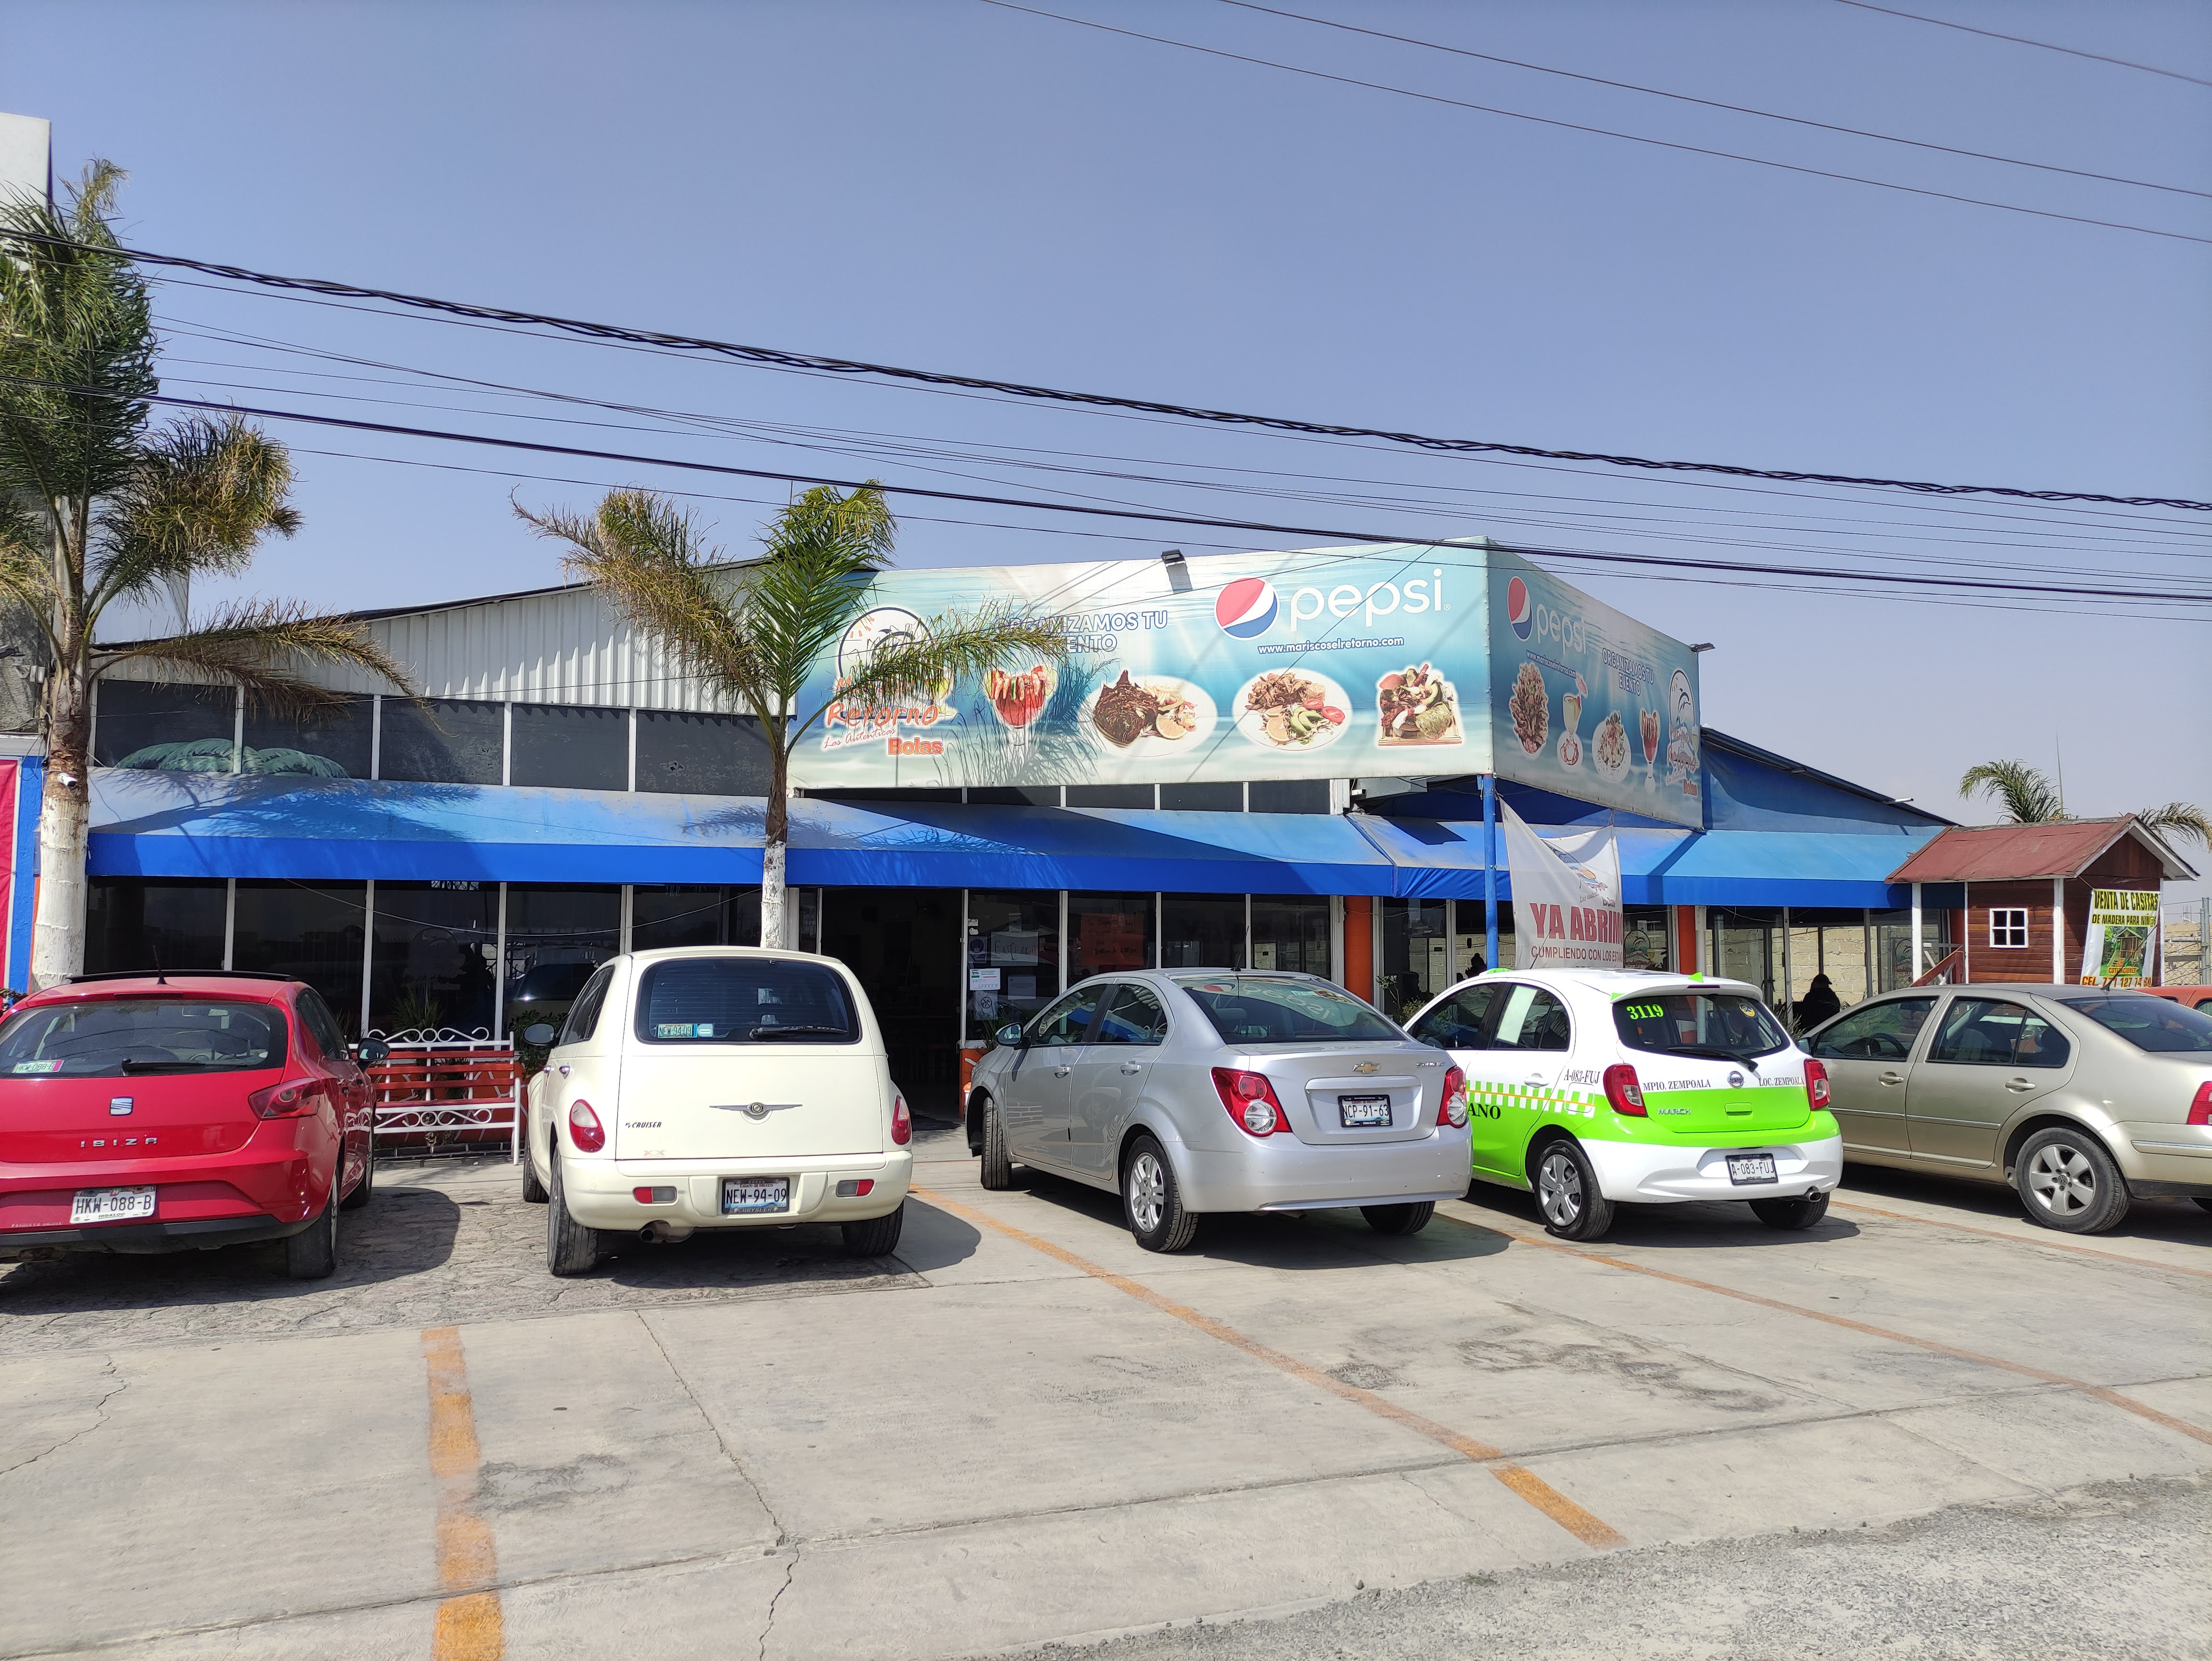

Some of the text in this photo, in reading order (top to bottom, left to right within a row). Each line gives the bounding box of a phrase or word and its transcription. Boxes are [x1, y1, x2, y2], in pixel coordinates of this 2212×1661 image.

[1291, 568, 1442, 632] pepsi
[1142, 610, 1168, 629] TU
[1537, 603, 1586, 656] pepsi
[1258, 636, 1404, 654] www.mariscoselretorno.com
[1602, 648, 1653, 684] ORGANIZAMOS TU
[1618, 672, 1640, 696] EVENTO
[888, 737, 943, 755] Bolas
[2094, 891, 2158, 911] VENTA DE CASITAS
[1529, 903, 1565, 940] YA
[2092, 914, 2100, 924] DE
[2102, 915, 2124, 924] MADERA
[2126, 916, 2139, 925] PARA
[1531, 946, 1586, 960] CUMPLIENDO
[1589, 949, 1601, 961] CON
[1603, 950, 1611, 961] LOS
[2120, 977, 2132, 987] 127
[2134, 977, 2141, 987] 74
[1626, 1004, 1664, 1019] 3119
[1564, 1069, 1601, 1084] A-083-FUJ
[1759, 1076, 1804, 1086] LOC. ZEMPOALA
[1643, 1079, 1711, 1091] MPIO. ZEMPOALA
[1342, 1104, 1389, 1118] NCP-91-63
[80, 1137, 157, 1148] IBIZA
[1731, 1161, 1774, 1176] A-083-FUJ
[726, 1188, 786, 1204] NEW-94-09
[76, 1195, 152, 1214] HKW-088-B
